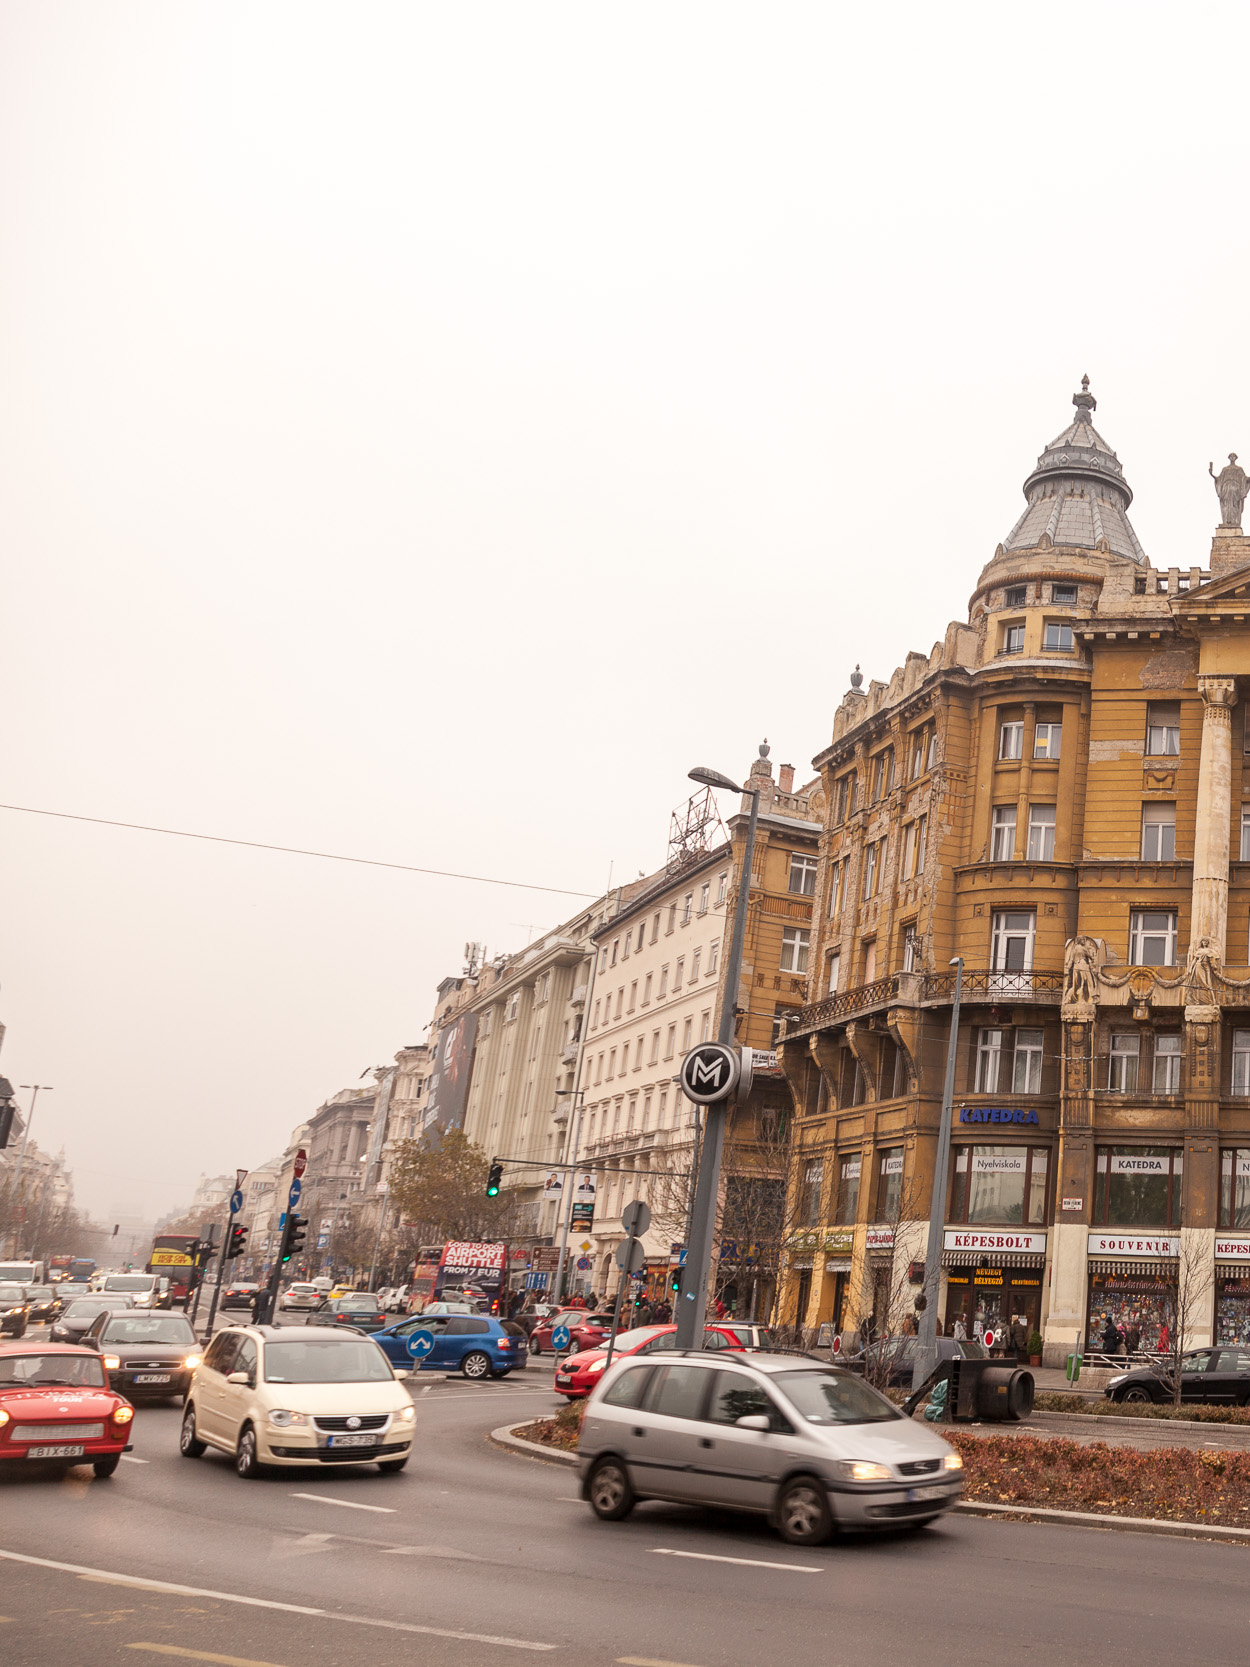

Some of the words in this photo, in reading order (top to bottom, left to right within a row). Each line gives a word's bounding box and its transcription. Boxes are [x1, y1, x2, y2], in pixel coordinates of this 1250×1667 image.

[960, 1108, 1039, 1124] KATEDRA
[977, 1159, 1021, 1170] Nyelviskola
[1118, 1160, 1162, 1170] KATEDRA
[954, 1233, 1032, 1249] KÉPESBOLT
[1099, 1239, 1170, 1251] SOUVENIR
[446, 1247, 504, 1259] AIRPORT
[444, 1256, 503, 1268] SHUTTLE
[443, 1266, 468, 1274] FROM
[469, 1268, 477, 1276] 7
[477, 1268, 500, 1277] EUR
[36, 1446, 82, 1457] BIX-661
